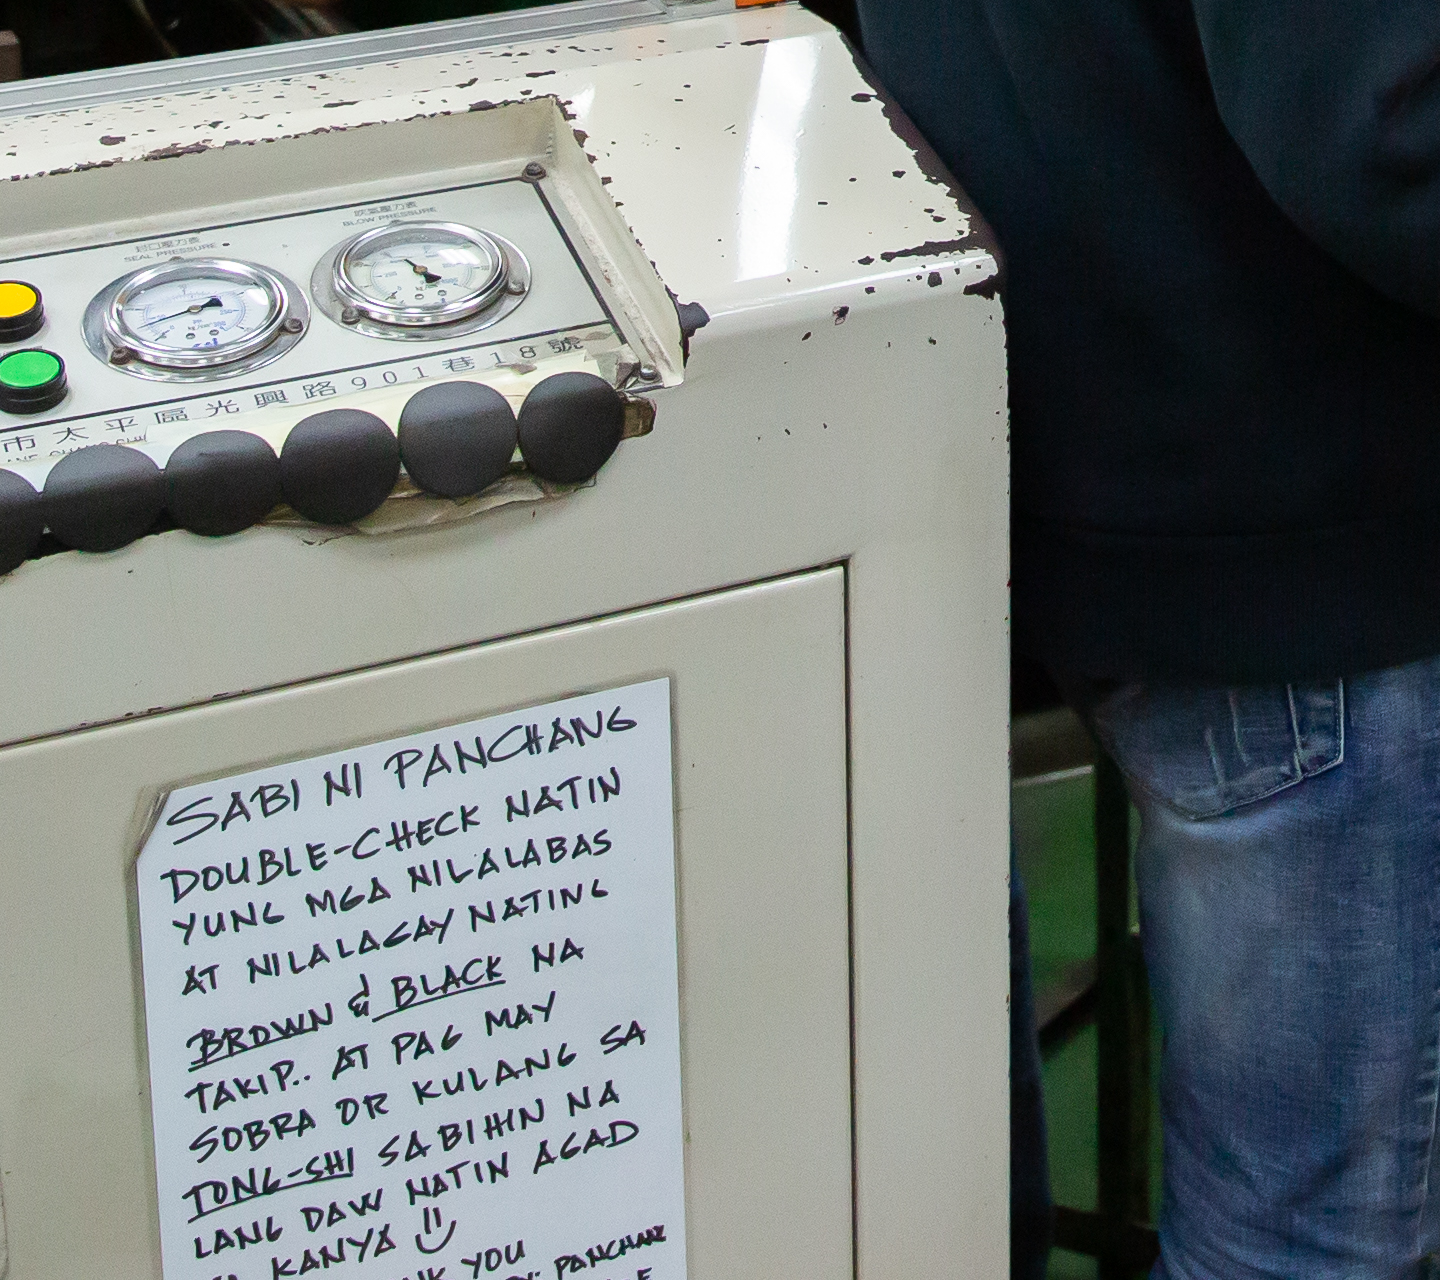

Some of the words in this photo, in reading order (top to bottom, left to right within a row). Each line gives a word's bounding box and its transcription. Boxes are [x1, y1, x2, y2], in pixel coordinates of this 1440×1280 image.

[123, 255, 153, 263] SEAL
[156, 243, 216, 258] PRESSURE
[342, 218, 376, 227] BLOW
[378, 207, 437, 221] PRESSURE
[160, 805, 480, 902] DOUBLE-CHECK
[506, 767, 622, 823] NATIN
[167, 779, 301, 845] SABI
[325, 763, 362, 808] NI
[384, 706, 637, 789] PANCHANG
[172, 900, 284, 945] YUNG
[305, 876, 391, 918] MGA
[409, 829, 612, 892] NILALABAS
[180, 963, 220, 996] AT
[247, 908, 455, 979] NILALAGAY
[469, 878, 608, 931] NATING
[187, 1002, 333, 1064] BROWN
[391, 954, 504, 1009] BLACK
[530, 938, 585, 972] NA
[331, 1043, 369, 1081] AT
[390, 1024, 463, 1065] PAG
[484, 991, 556, 1038] MAY
[183, 1147, 355, 1211] TONG-SHI
[377, 1098, 546, 1165] SABIHIN
[566, 1080, 620, 1117] NA
[189, 1109, 316, 1163] SOBRA
[335, 1093, 389, 1127] OR
[413, 1043, 577, 1102] KULANG
[599, 1020, 646, 1054] SA
[193, 1209, 284, 1259] LANG
[299, 1191, 383, 1233] DAW
[406, 1153, 509, 1206] NATIN
[532, 1120, 638, 1174] AGAD
[272, 1223, 397, 1280] KANYA
[461, 1239, 526, 1280] YOU
